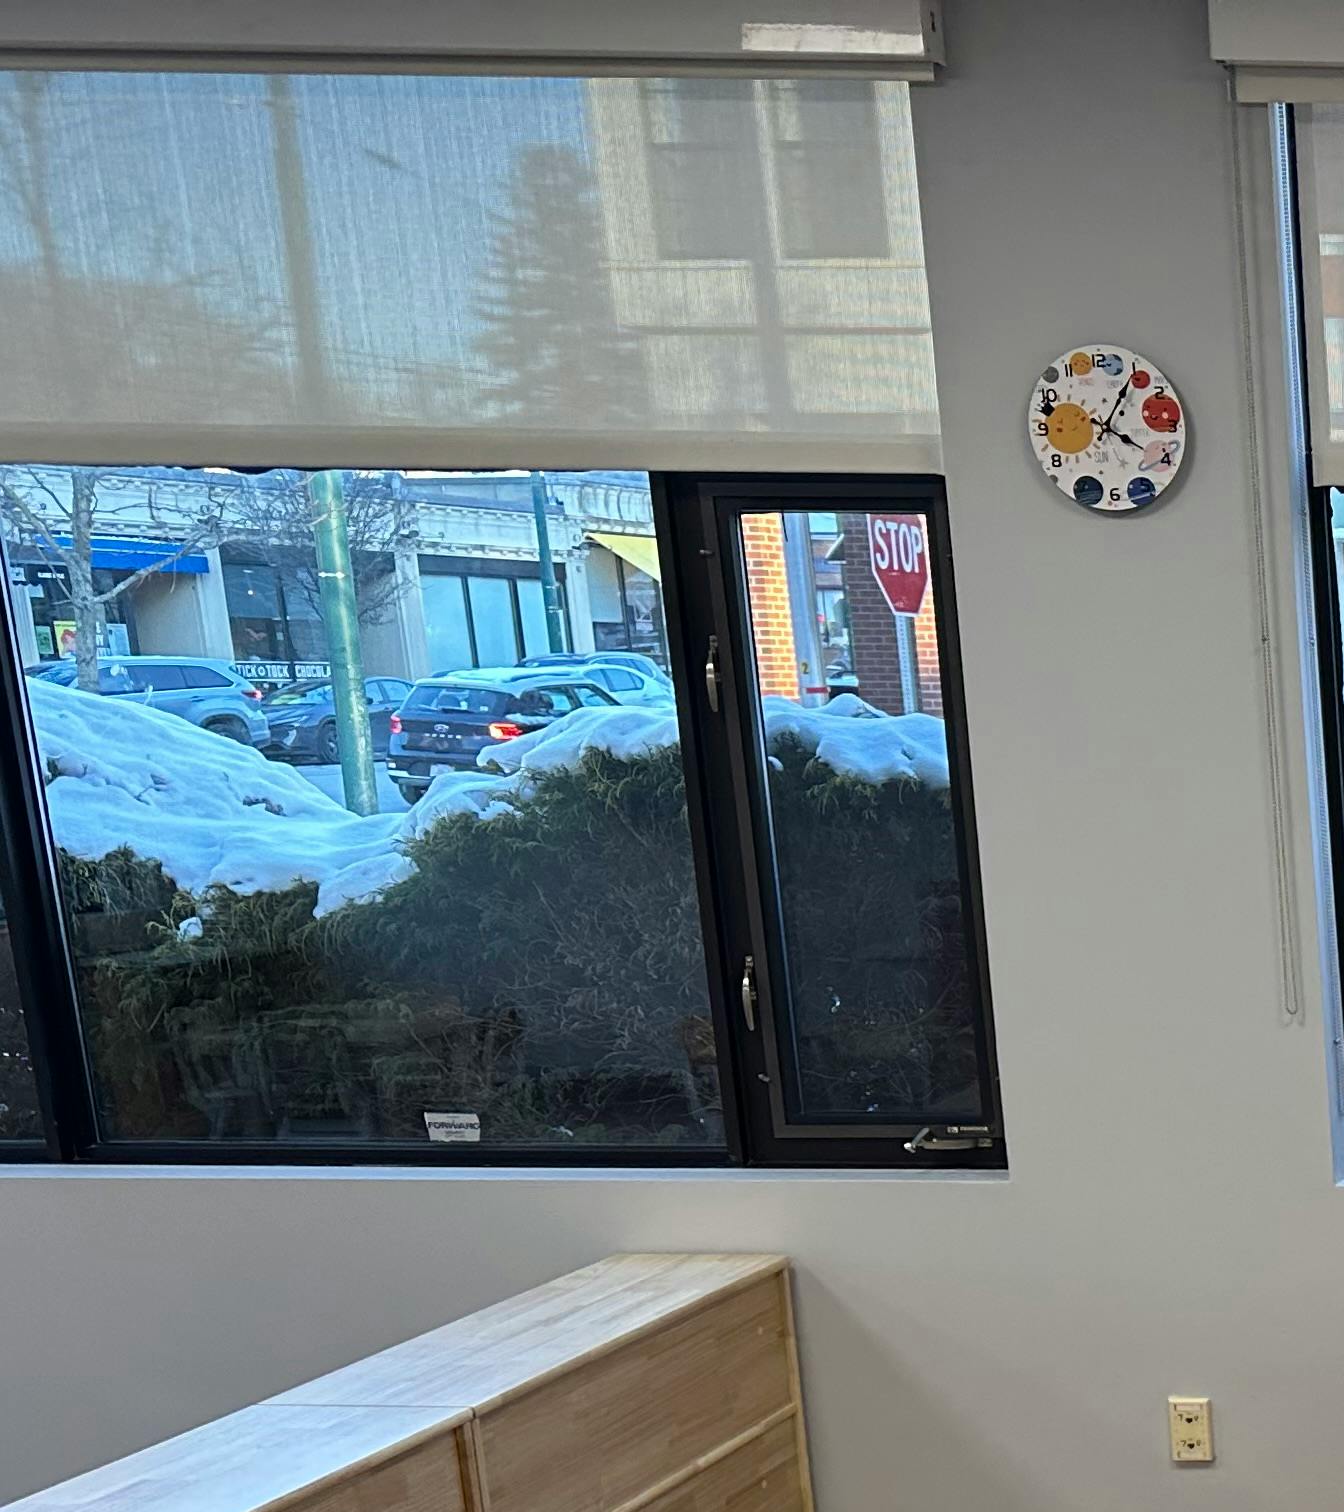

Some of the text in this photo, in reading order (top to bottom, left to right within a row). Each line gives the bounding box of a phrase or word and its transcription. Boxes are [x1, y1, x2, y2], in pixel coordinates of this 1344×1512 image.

[1092, 354, 1106, 368] 12
[1065, 364, 1073, 378] 11
[1042, 389, 1058, 403] 10
[1154, 386, 1165, 400] 2
[1038, 423, 1049, 437] 9
[1168, 420, 1178, 433] 3
[1051, 454, 1063, 468] 8
[1161, 453, 1171, 466] 4
[1110, 488, 1121, 502] 6
[874, 519, 922, 573] STOP
[236, 664, 290, 678] TICK TOCK
[294, 664, 331, 678] CHOCOLA
[801, 662, 809, 675] 2
